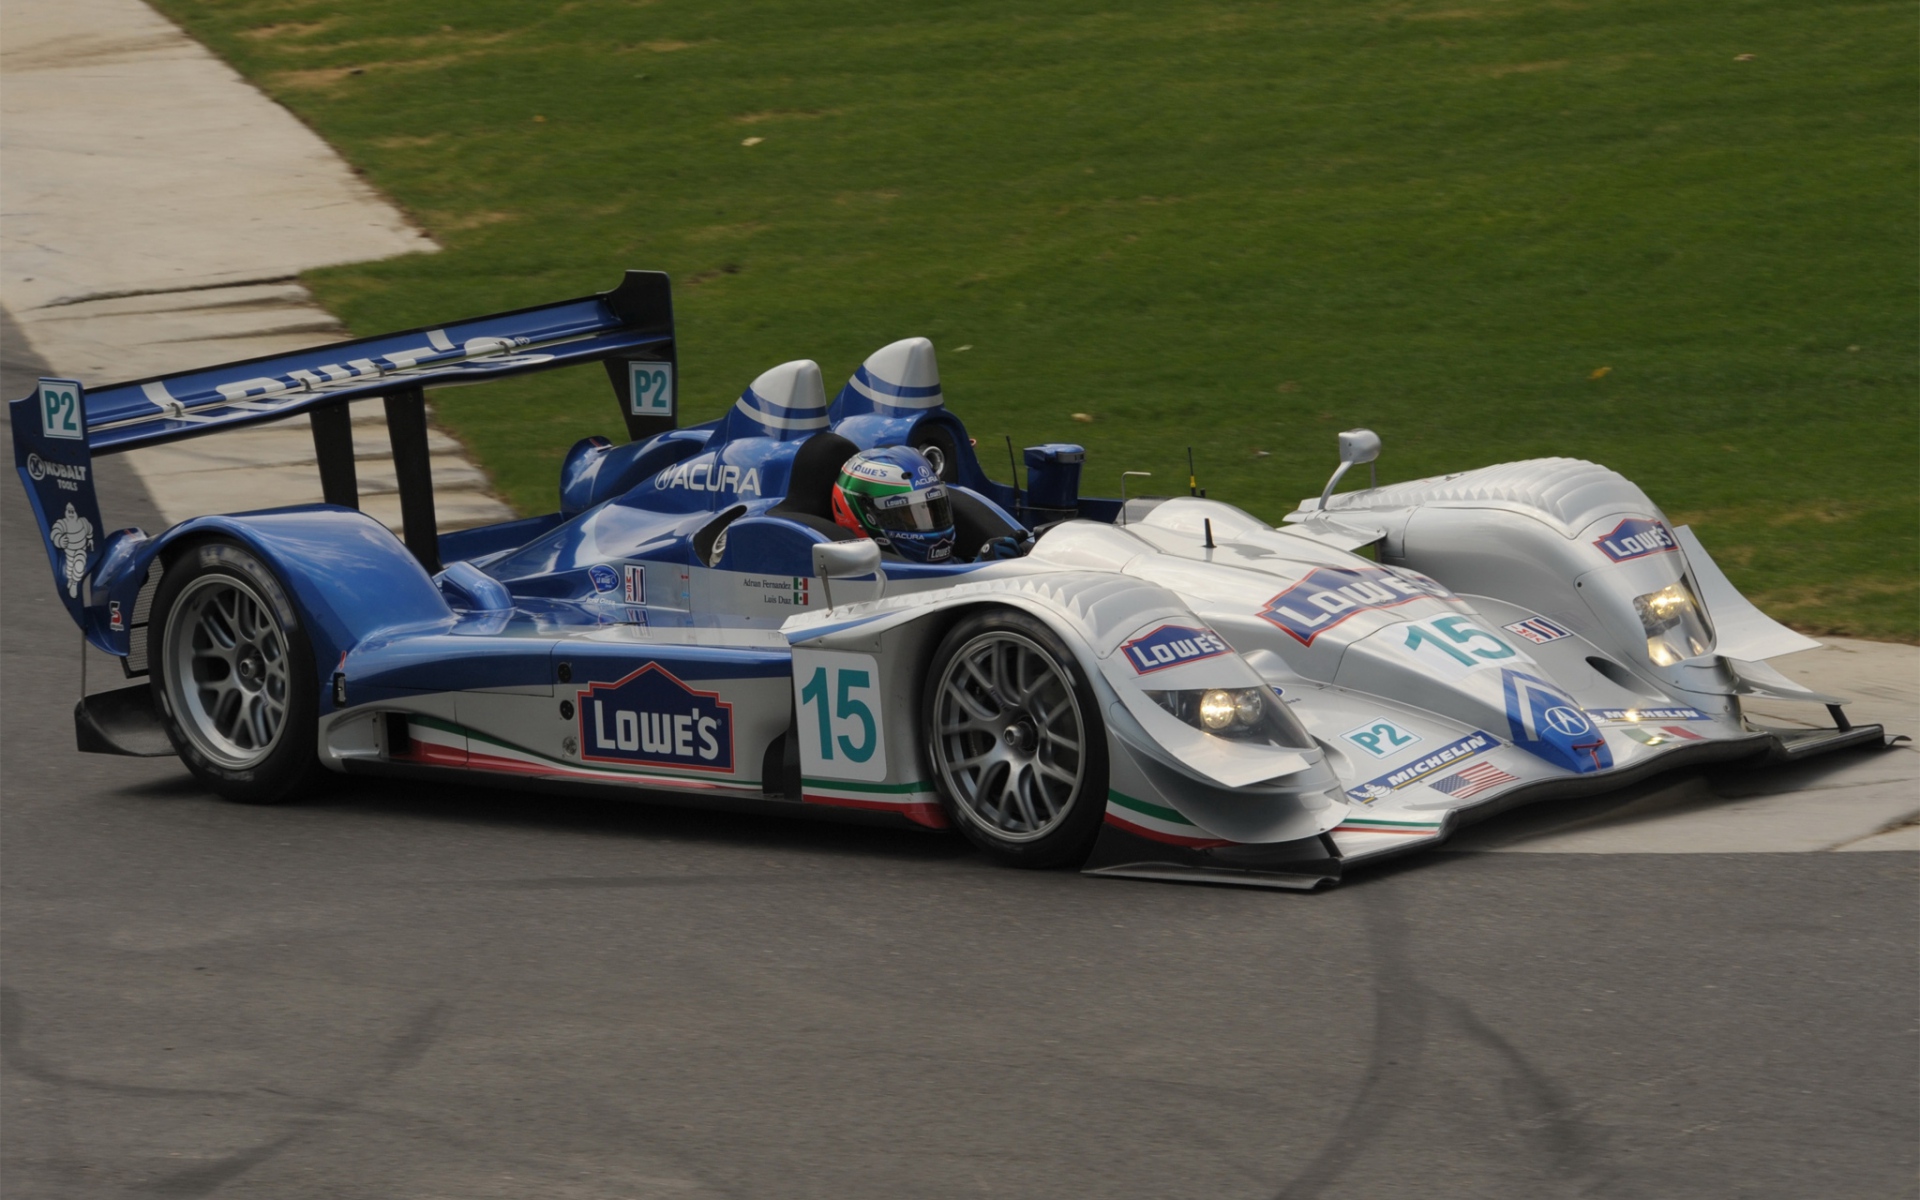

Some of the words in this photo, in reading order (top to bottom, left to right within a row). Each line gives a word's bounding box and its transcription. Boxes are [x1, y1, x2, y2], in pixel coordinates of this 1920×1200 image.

[635, 370, 667, 408] P2
[44, 390, 77, 431] P2
[45, 460, 87, 481] KOBALT
[57, 479, 78, 491] TOOLS
[669, 463, 762, 496] ACURA
[914, 476, 939, 487] ACURA
[1604, 525, 1673, 557] LOWE'S
[1132, 633, 1227, 668] LOWE'S
[1404, 616, 1516, 667] 15
[593, 700, 719, 760] LOWE'S
[801, 666, 877, 763] 15
[1603, 709, 1699, 719] MHELIN
[1350, 723, 1412, 755] P2
[1387, 735, 1487, 787] MICHELIN
